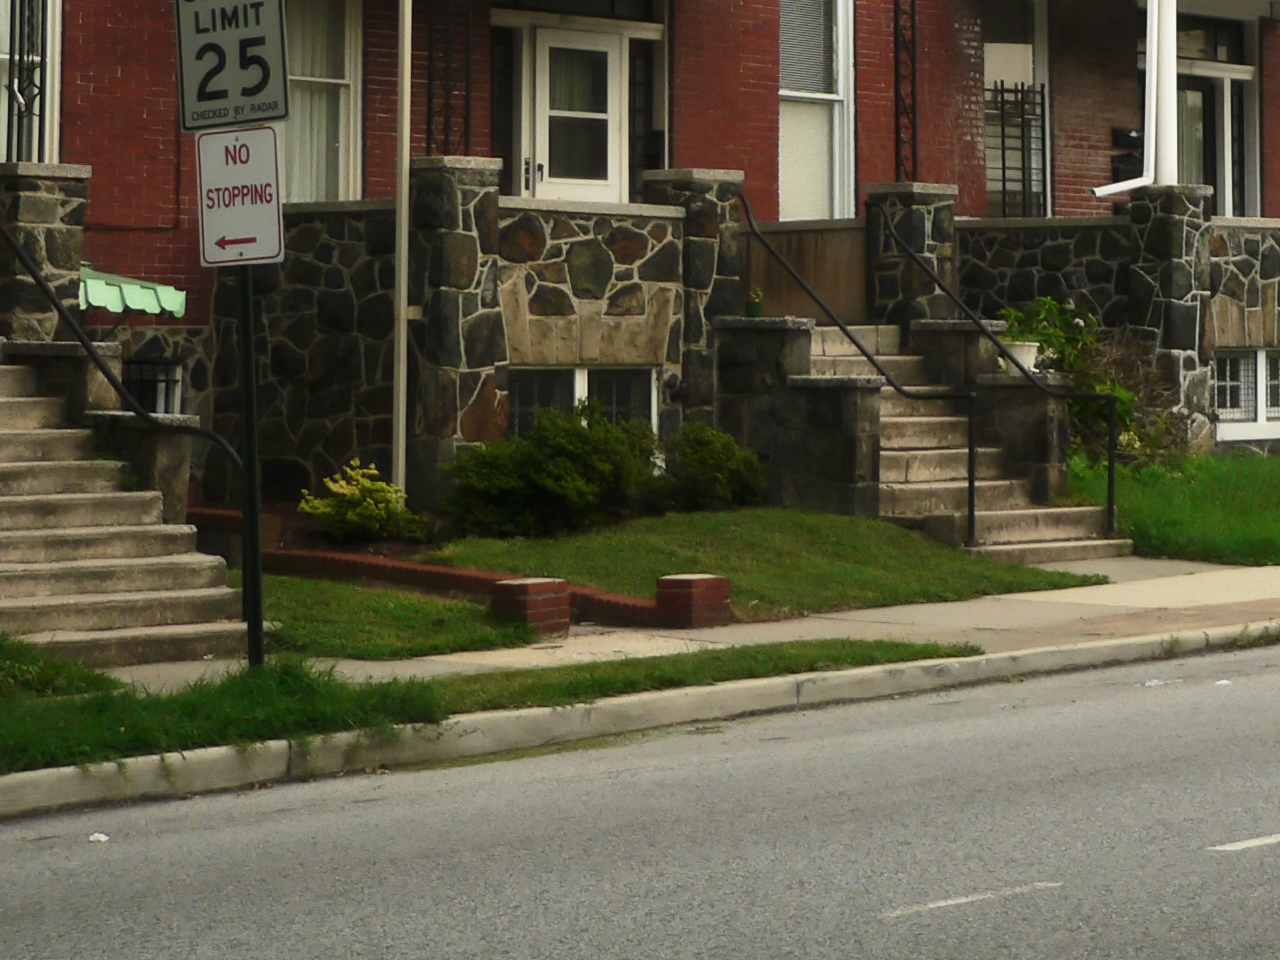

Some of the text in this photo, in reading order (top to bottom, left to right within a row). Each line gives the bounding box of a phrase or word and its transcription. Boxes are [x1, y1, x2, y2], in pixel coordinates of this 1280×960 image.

[195, 1, 265, 34] LIMIT
[194, 36, 271, 102] 25
[191, 100, 279, 122] CHECKED BY RADAR
[224, 143, 250, 166] NO
[206, 182, 273, 209] STOPPING
